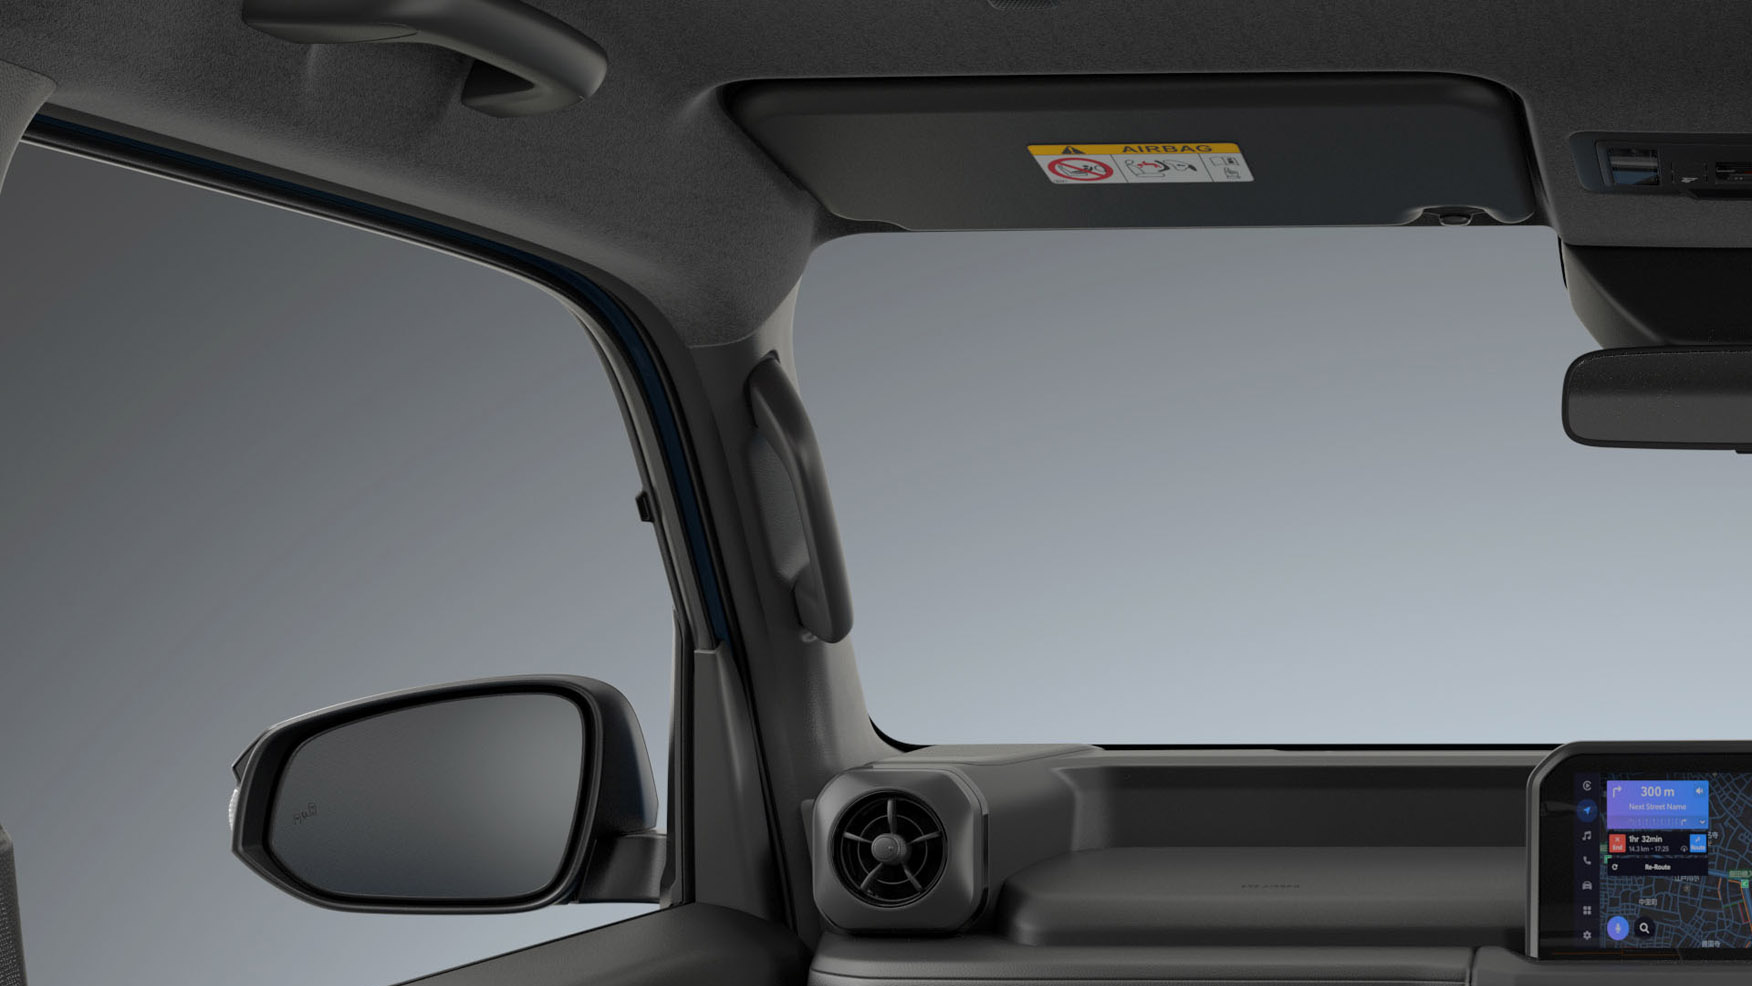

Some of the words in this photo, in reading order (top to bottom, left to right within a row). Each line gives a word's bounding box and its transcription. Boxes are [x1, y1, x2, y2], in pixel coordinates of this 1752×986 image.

[1122, 145, 1213, 153] AIRBAG
[1640, 786, 1662, 797] 300
[1664, 788, 1675, 797] m
[1629, 835, 1640, 843] 1hr
[1641, 835, 1664, 843] 32min
[1644, 863, 1672, 871] Re-Route
